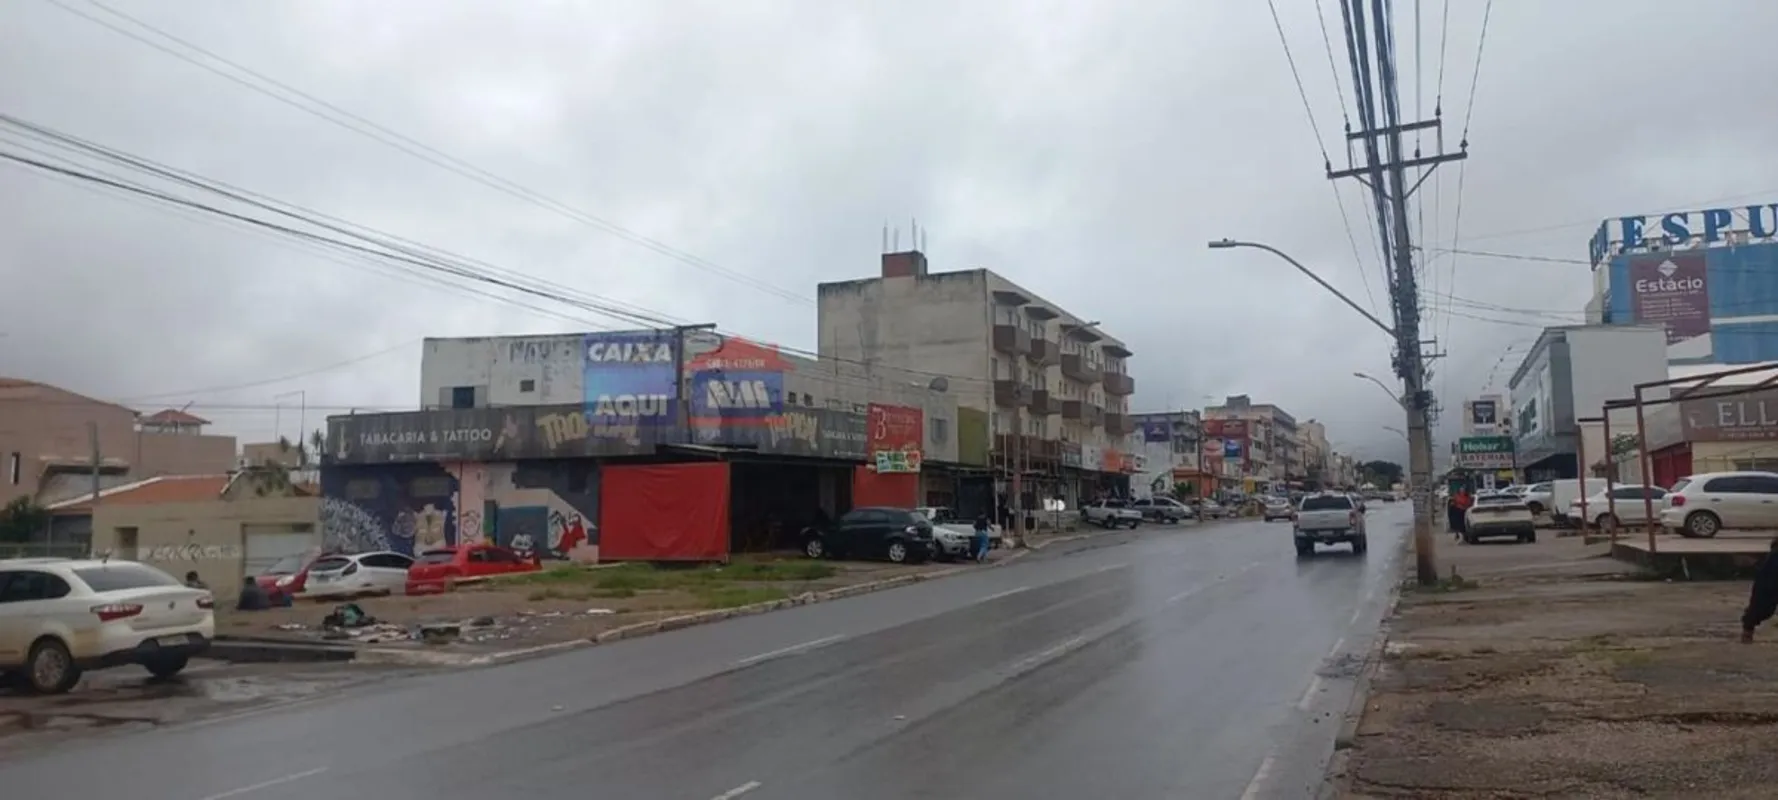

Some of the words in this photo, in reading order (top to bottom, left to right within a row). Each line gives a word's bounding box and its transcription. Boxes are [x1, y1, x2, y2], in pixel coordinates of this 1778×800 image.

[1635, 275, 1704, 293] Estácio
[359, 431, 426, 446] TABACARIA
[430, 430, 438, 442] &
[443, 427, 492, 442] TATTOO
